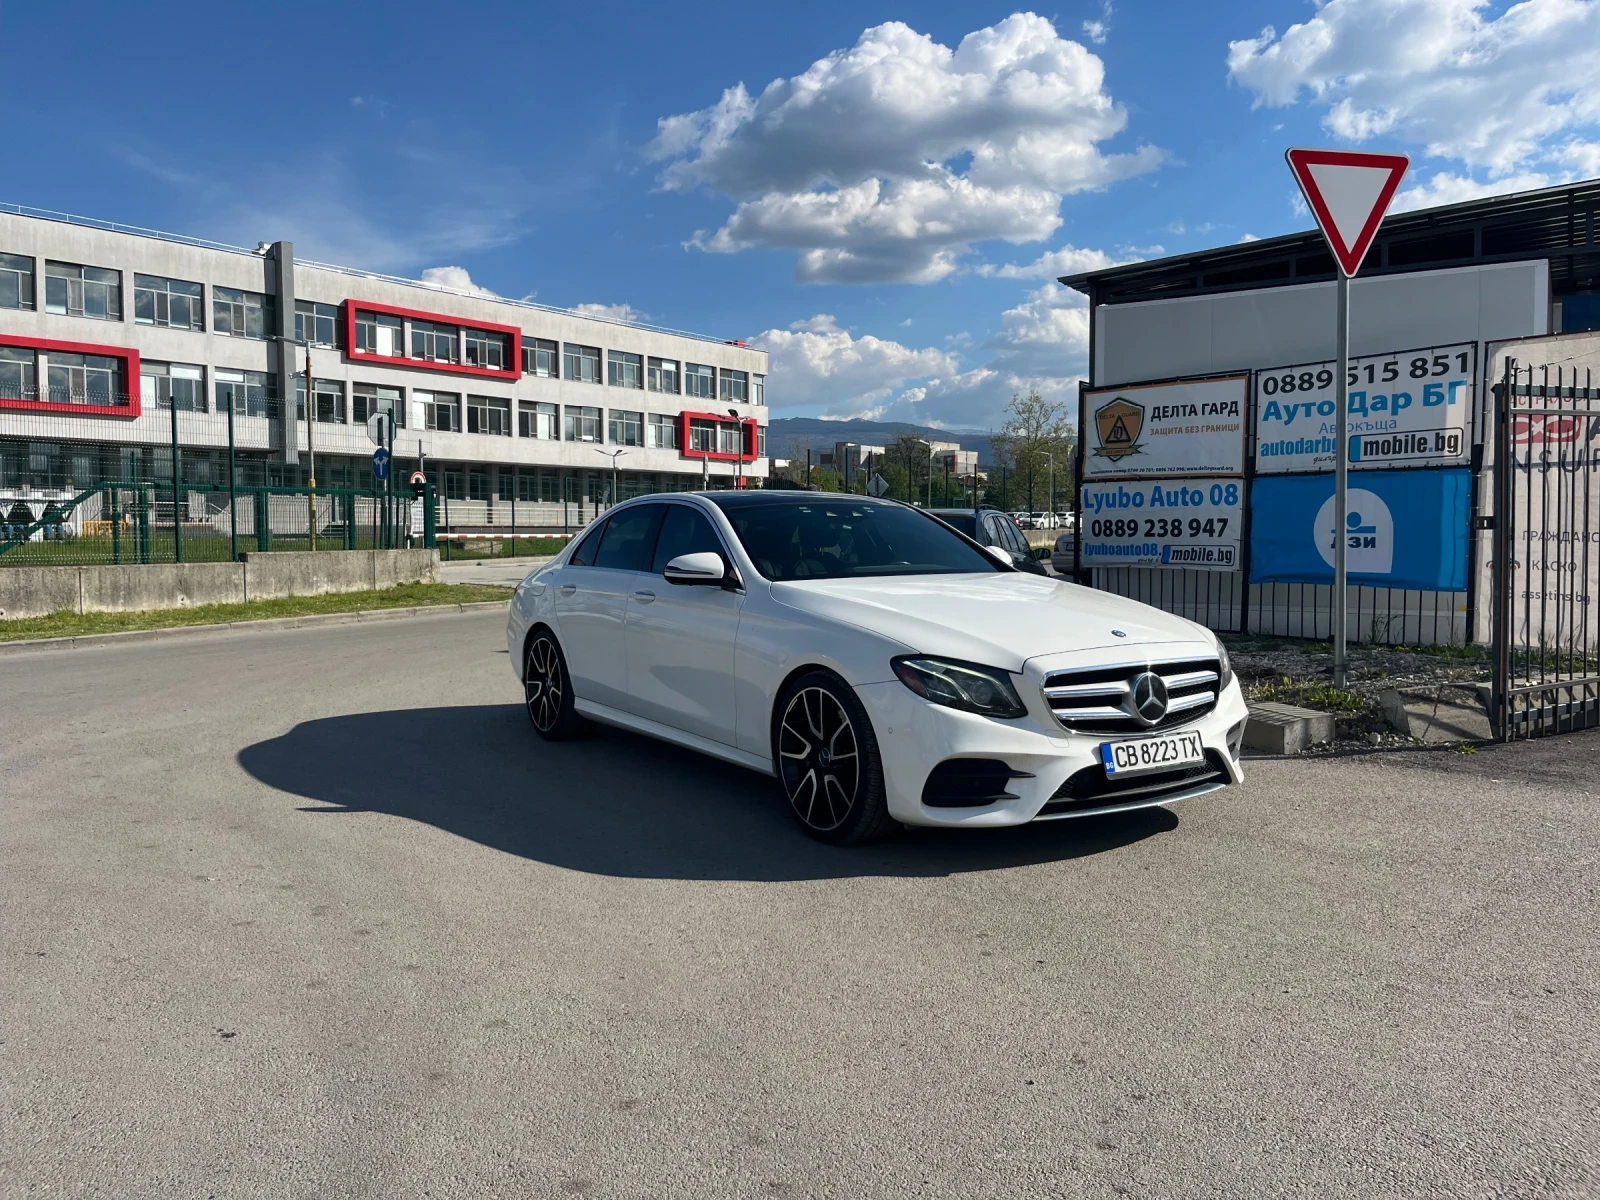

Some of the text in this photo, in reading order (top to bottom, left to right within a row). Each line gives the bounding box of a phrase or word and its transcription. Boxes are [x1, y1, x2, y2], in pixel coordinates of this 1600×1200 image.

[1262, 352, 1469, 396] 0889 515 851
[1151, 401, 1239, 422] ДЕЛТА ГАРД
[1262, 380, 1468, 426] Ауто Дар БГ
[1099, 412, 1116, 420] DELTA
[1150, 423, 1240, 436] ЗАЩИТА БЕЗ ГРАНИЦИ
[1318, 419, 1397, 435] Авокъща
[1363, 431, 1459, 457] mobile.bg
[1083, 483, 1239, 514] Lyubo Auto 08
[1091, 518, 1229, 538] 0889 238 947
[1170, 547, 1233, 563] mobile.bg
[1115, 736, 1200, 768] CB 8223 TX
[1105, 761, 1114, 769] BG
